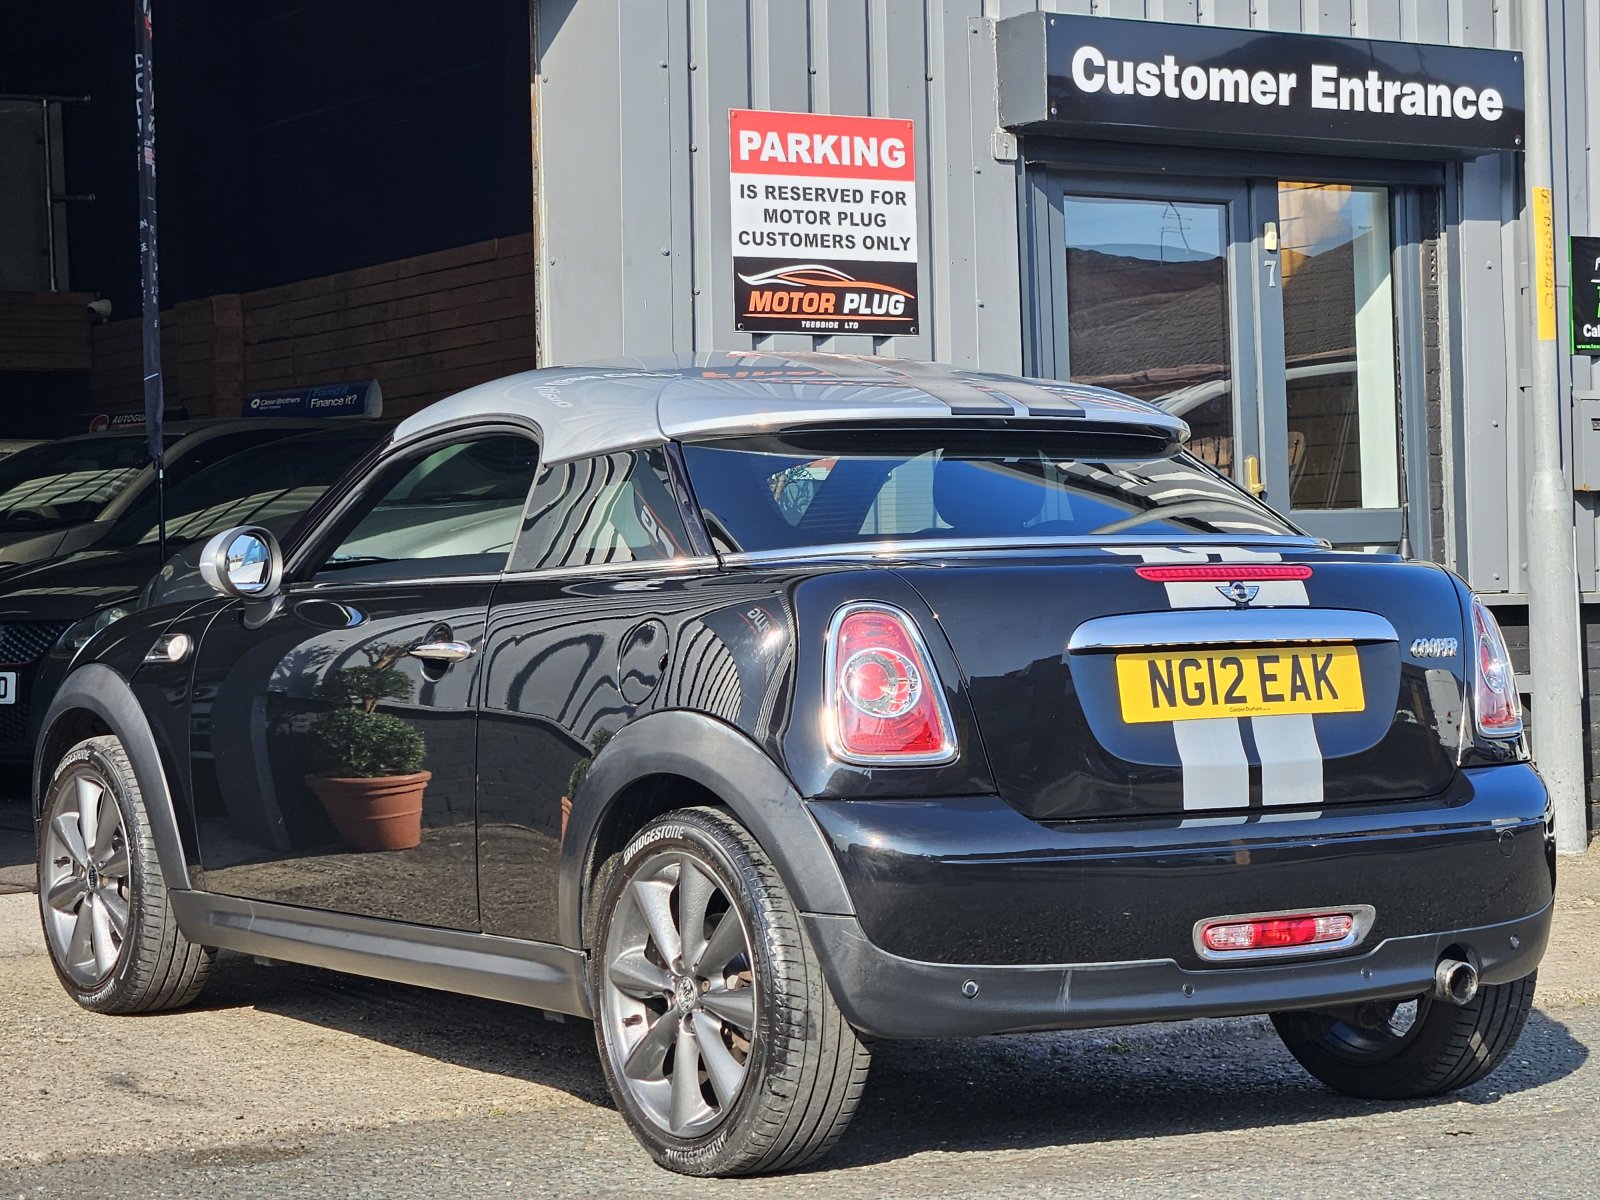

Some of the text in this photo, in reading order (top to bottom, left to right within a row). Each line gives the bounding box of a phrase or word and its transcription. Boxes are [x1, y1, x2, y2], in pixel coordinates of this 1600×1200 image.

[1072, 46, 1504, 121] Customer Entrance
[739, 130, 906, 168] PARKING
[740, 184, 907, 206] IS RESERVED FOR
[763, 208, 887, 227] MOTOR PLUG
[738, 230, 911, 251] CUSTOMERS ONLY
[1264, 260, 1277, 287] 7
[749, 290, 906, 315] MOTOR PLUG
[844, 321, 859, 329] LTD
[277, 397, 300, 405] Brothers
[310, 394, 357, 408] Finance it?
[1410, 637, 1458, 658] COOPER
[1148, 653, 1339, 709] NG12 EAK
[623, 824, 684, 866] BRIDGESTONE
